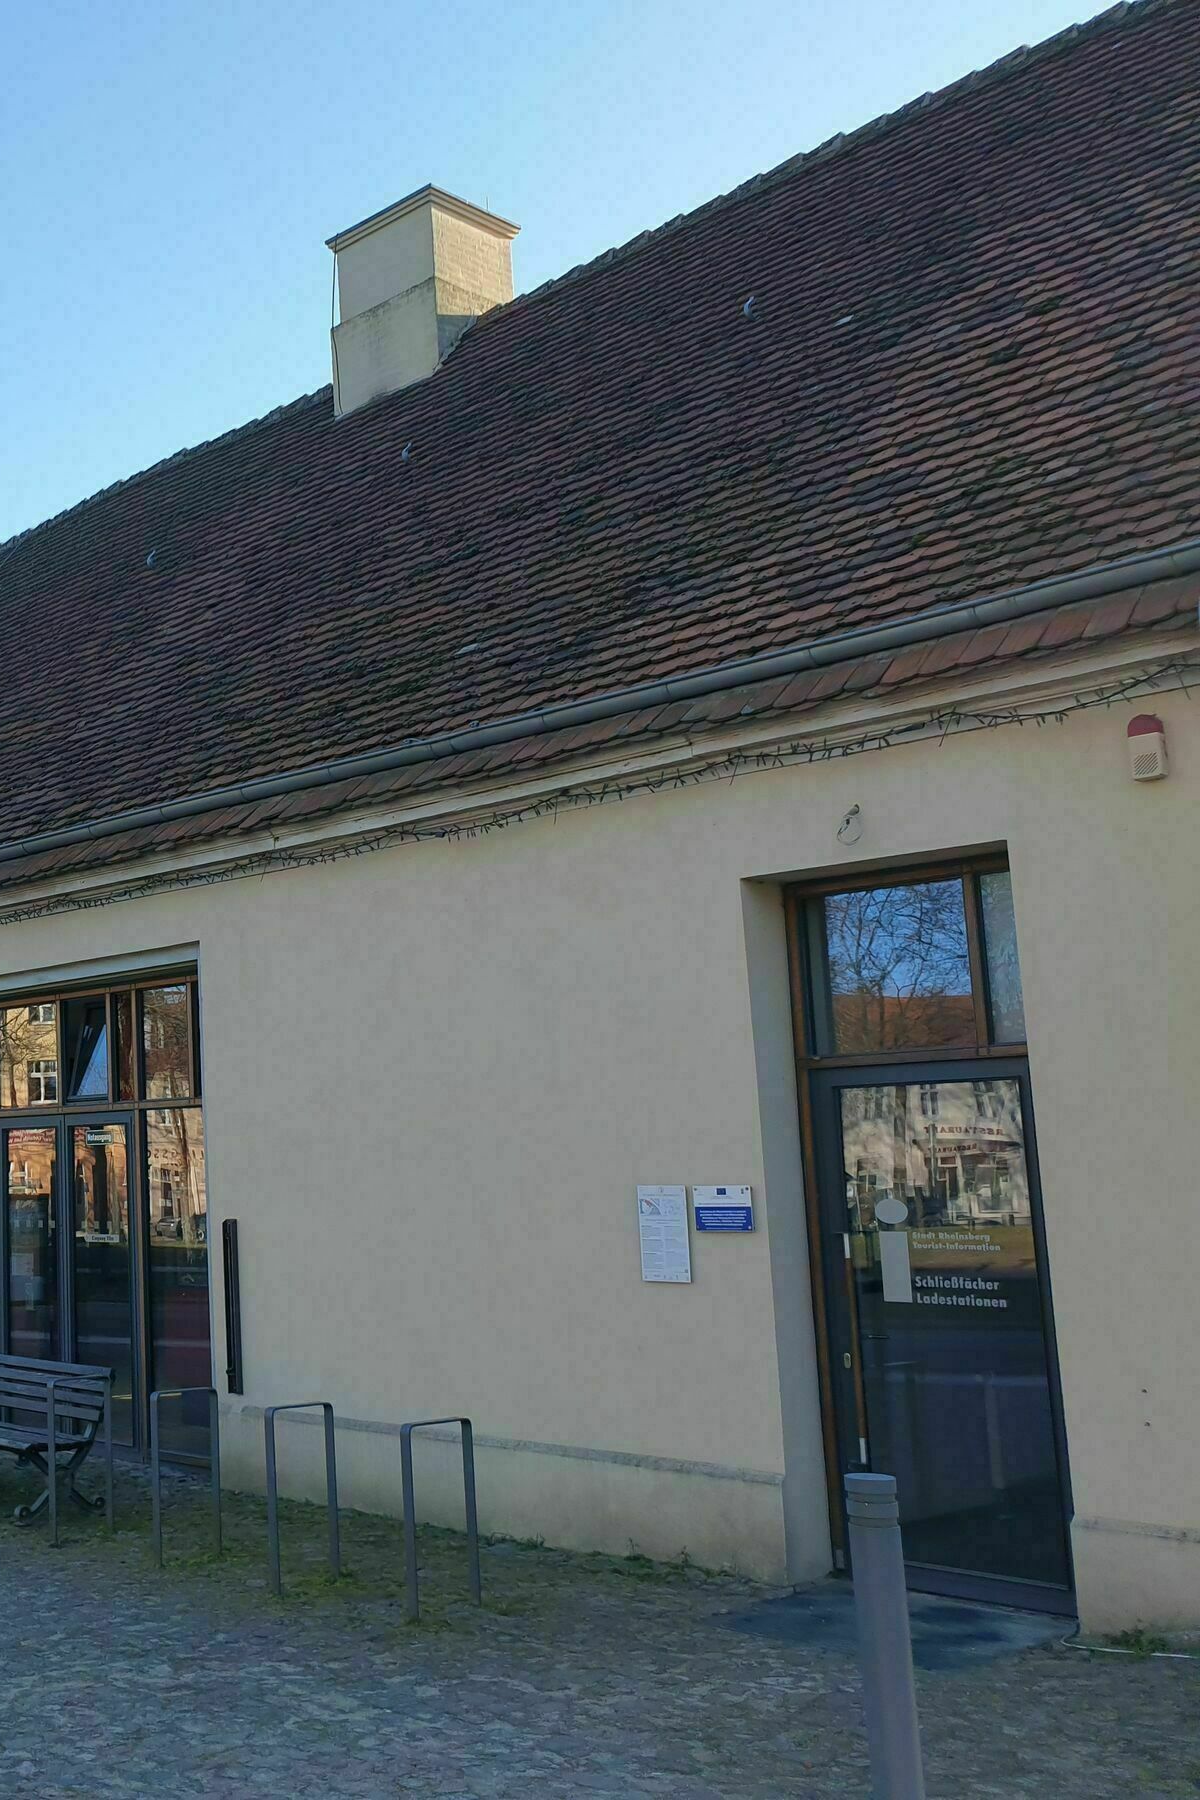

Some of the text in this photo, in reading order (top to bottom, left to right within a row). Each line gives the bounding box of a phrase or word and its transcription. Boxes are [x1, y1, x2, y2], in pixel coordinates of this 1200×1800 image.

[912, 1232, 991, 1243] Stadt Rheinsberg
[912, 1242, 1001, 1252] Tourist-Information
[915, 1276, 1000, 1291] Schließfächer
[917, 1293, 1008, 1308] Ladestationen
